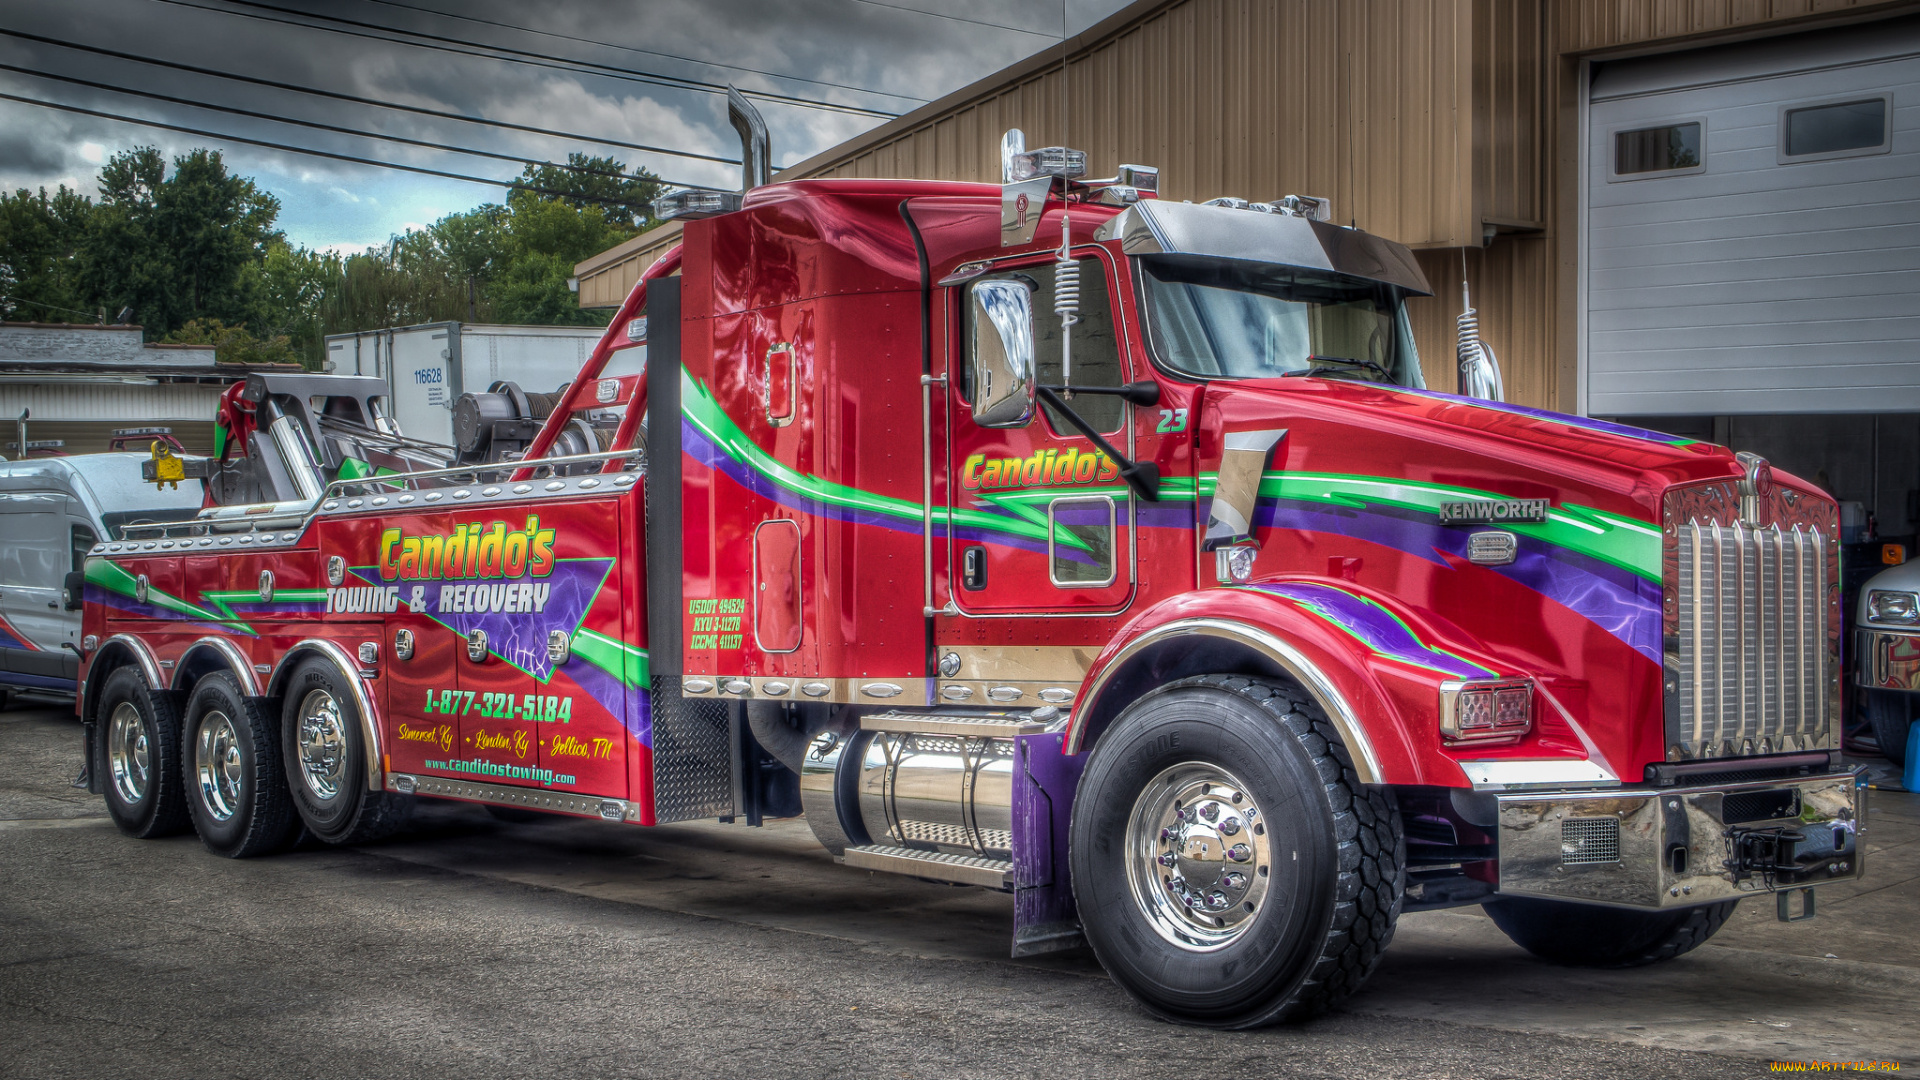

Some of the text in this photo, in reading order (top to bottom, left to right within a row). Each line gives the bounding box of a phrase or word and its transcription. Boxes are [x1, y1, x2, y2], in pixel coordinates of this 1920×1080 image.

[414, 367, 442, 385] 116628
[1156, 408, 1188, 433] 23
[962, 446, 1122, 490] Candido's
[1440, 500, 1545, 519] KENWORTH
[380, 514, 556, 582] Candido's
[326, 582, 551, 613] TOWING & RECOVERY
[689, 598, 745, 614] USDOT 494524
[693, 616, 741, 632] KYU 3-11278
[690, 634, 743, 649] ICCMC 411137
[423, 689, 573, 723] 1-877-321-5184
[398, 723, 613, 761] Somerset, Ky London, Ky Jellico, TN
[425, 758, 576, 785] www.candidostowing.com
